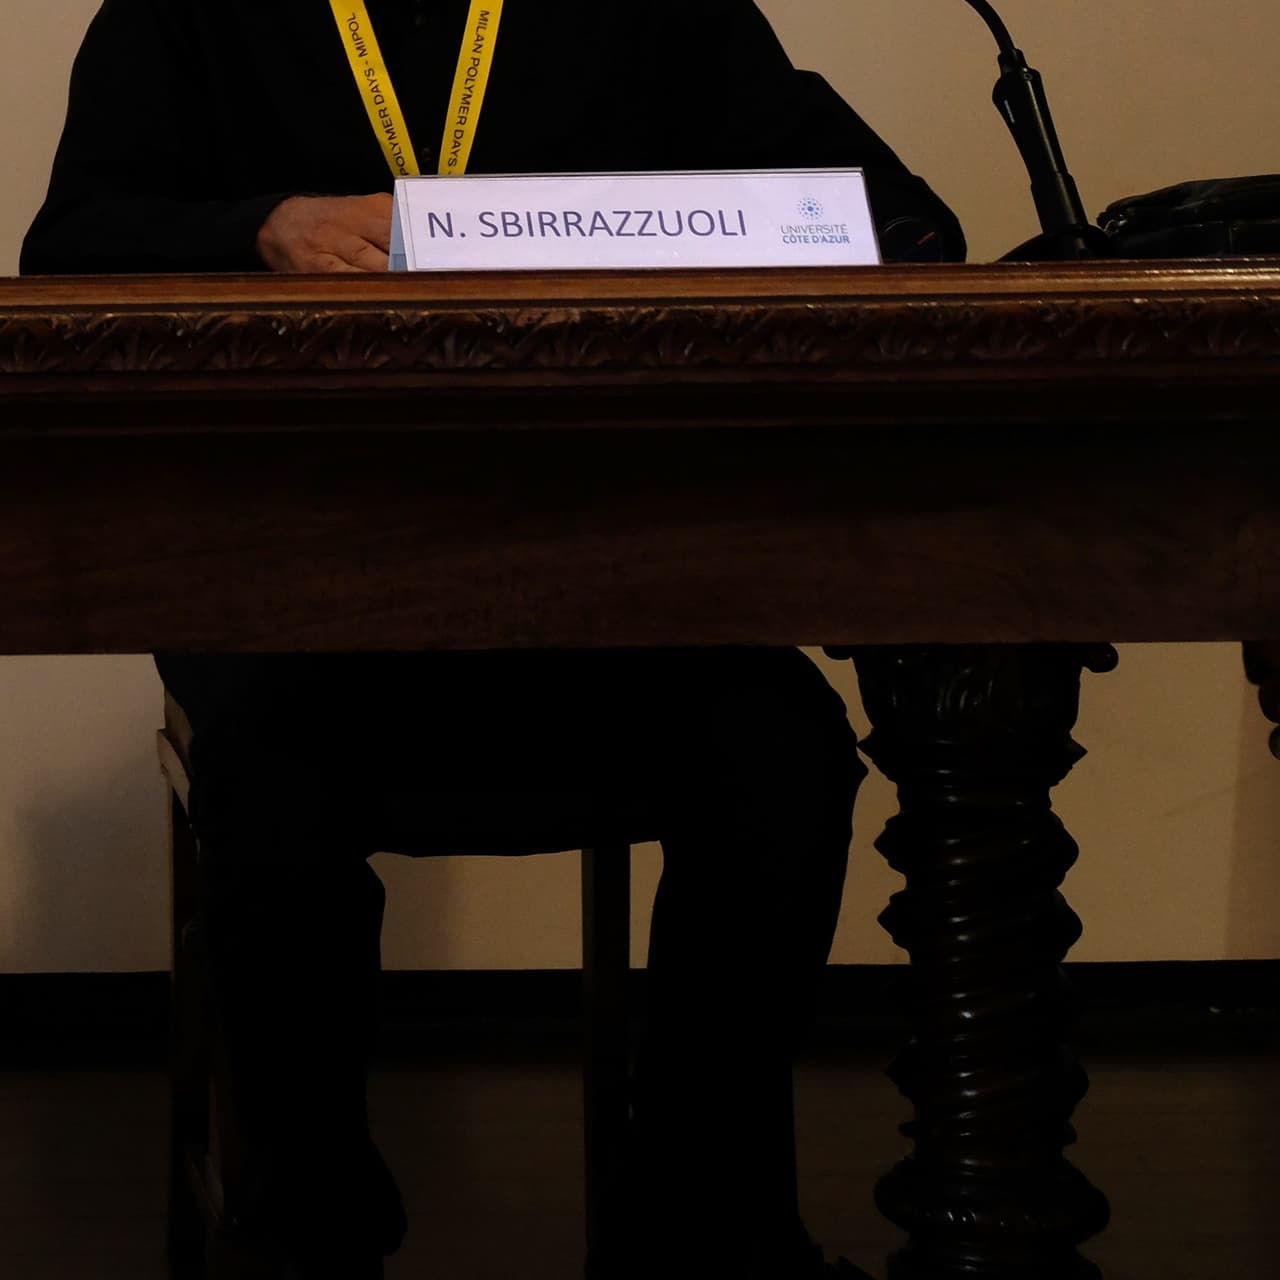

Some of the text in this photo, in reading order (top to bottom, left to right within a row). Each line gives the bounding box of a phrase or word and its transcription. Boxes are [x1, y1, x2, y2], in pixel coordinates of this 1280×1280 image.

[346, 12, 369, 58] MIPOL
[471, 8, 491, 55] MILAN
[363, 67, 386, 106] DAYS
[453, 57, 481, 127] POLYMER
[378, 106, 410, 177] POLYMER
[447, 128, 465, 168] DAYS
[427, 208, 747, 239] N. SBIRRAZZUOLI
[780, 223, 849, 235] UNIVERSITÉ
[782, 234, 851, 244] CÔTE D'AZUR
